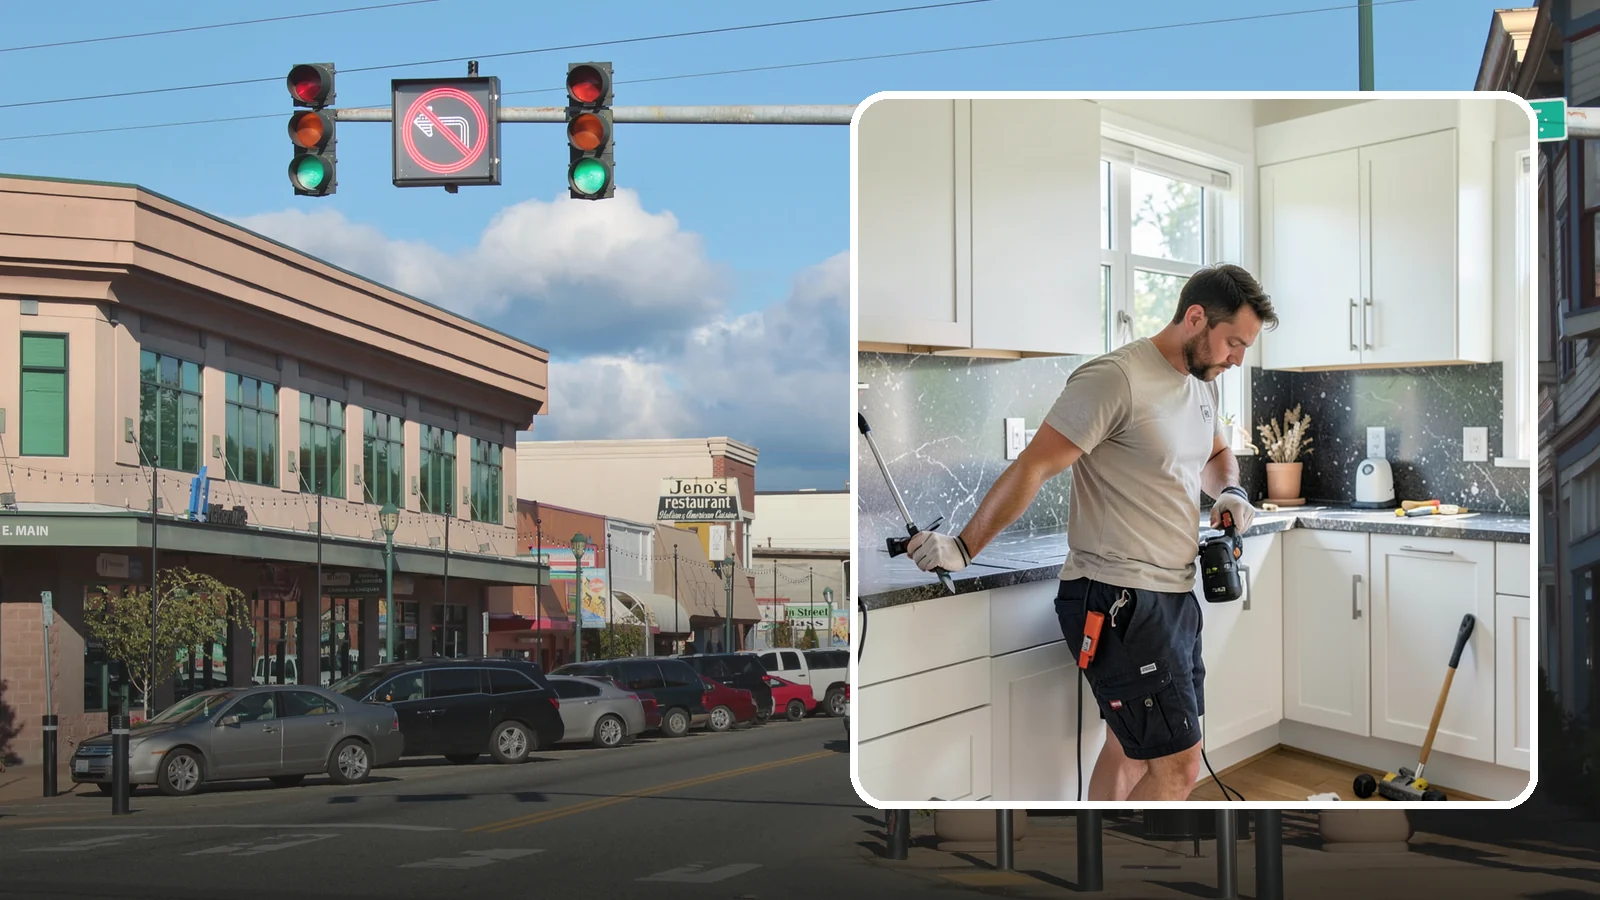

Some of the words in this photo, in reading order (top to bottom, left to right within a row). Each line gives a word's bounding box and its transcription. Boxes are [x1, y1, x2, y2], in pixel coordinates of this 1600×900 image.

[670, 480, 727, 494] Jeno's
[665, 496, 731, 509] restaurant
[686, 510, 714, 519] American
[715, 509, 738, 519] Cuisine
[2, 525, 13, 536] E.
[15, 525, 49, 536] MAIN
[797, 607, 828, 617] Street
[791, 619, 824, 627] lass
